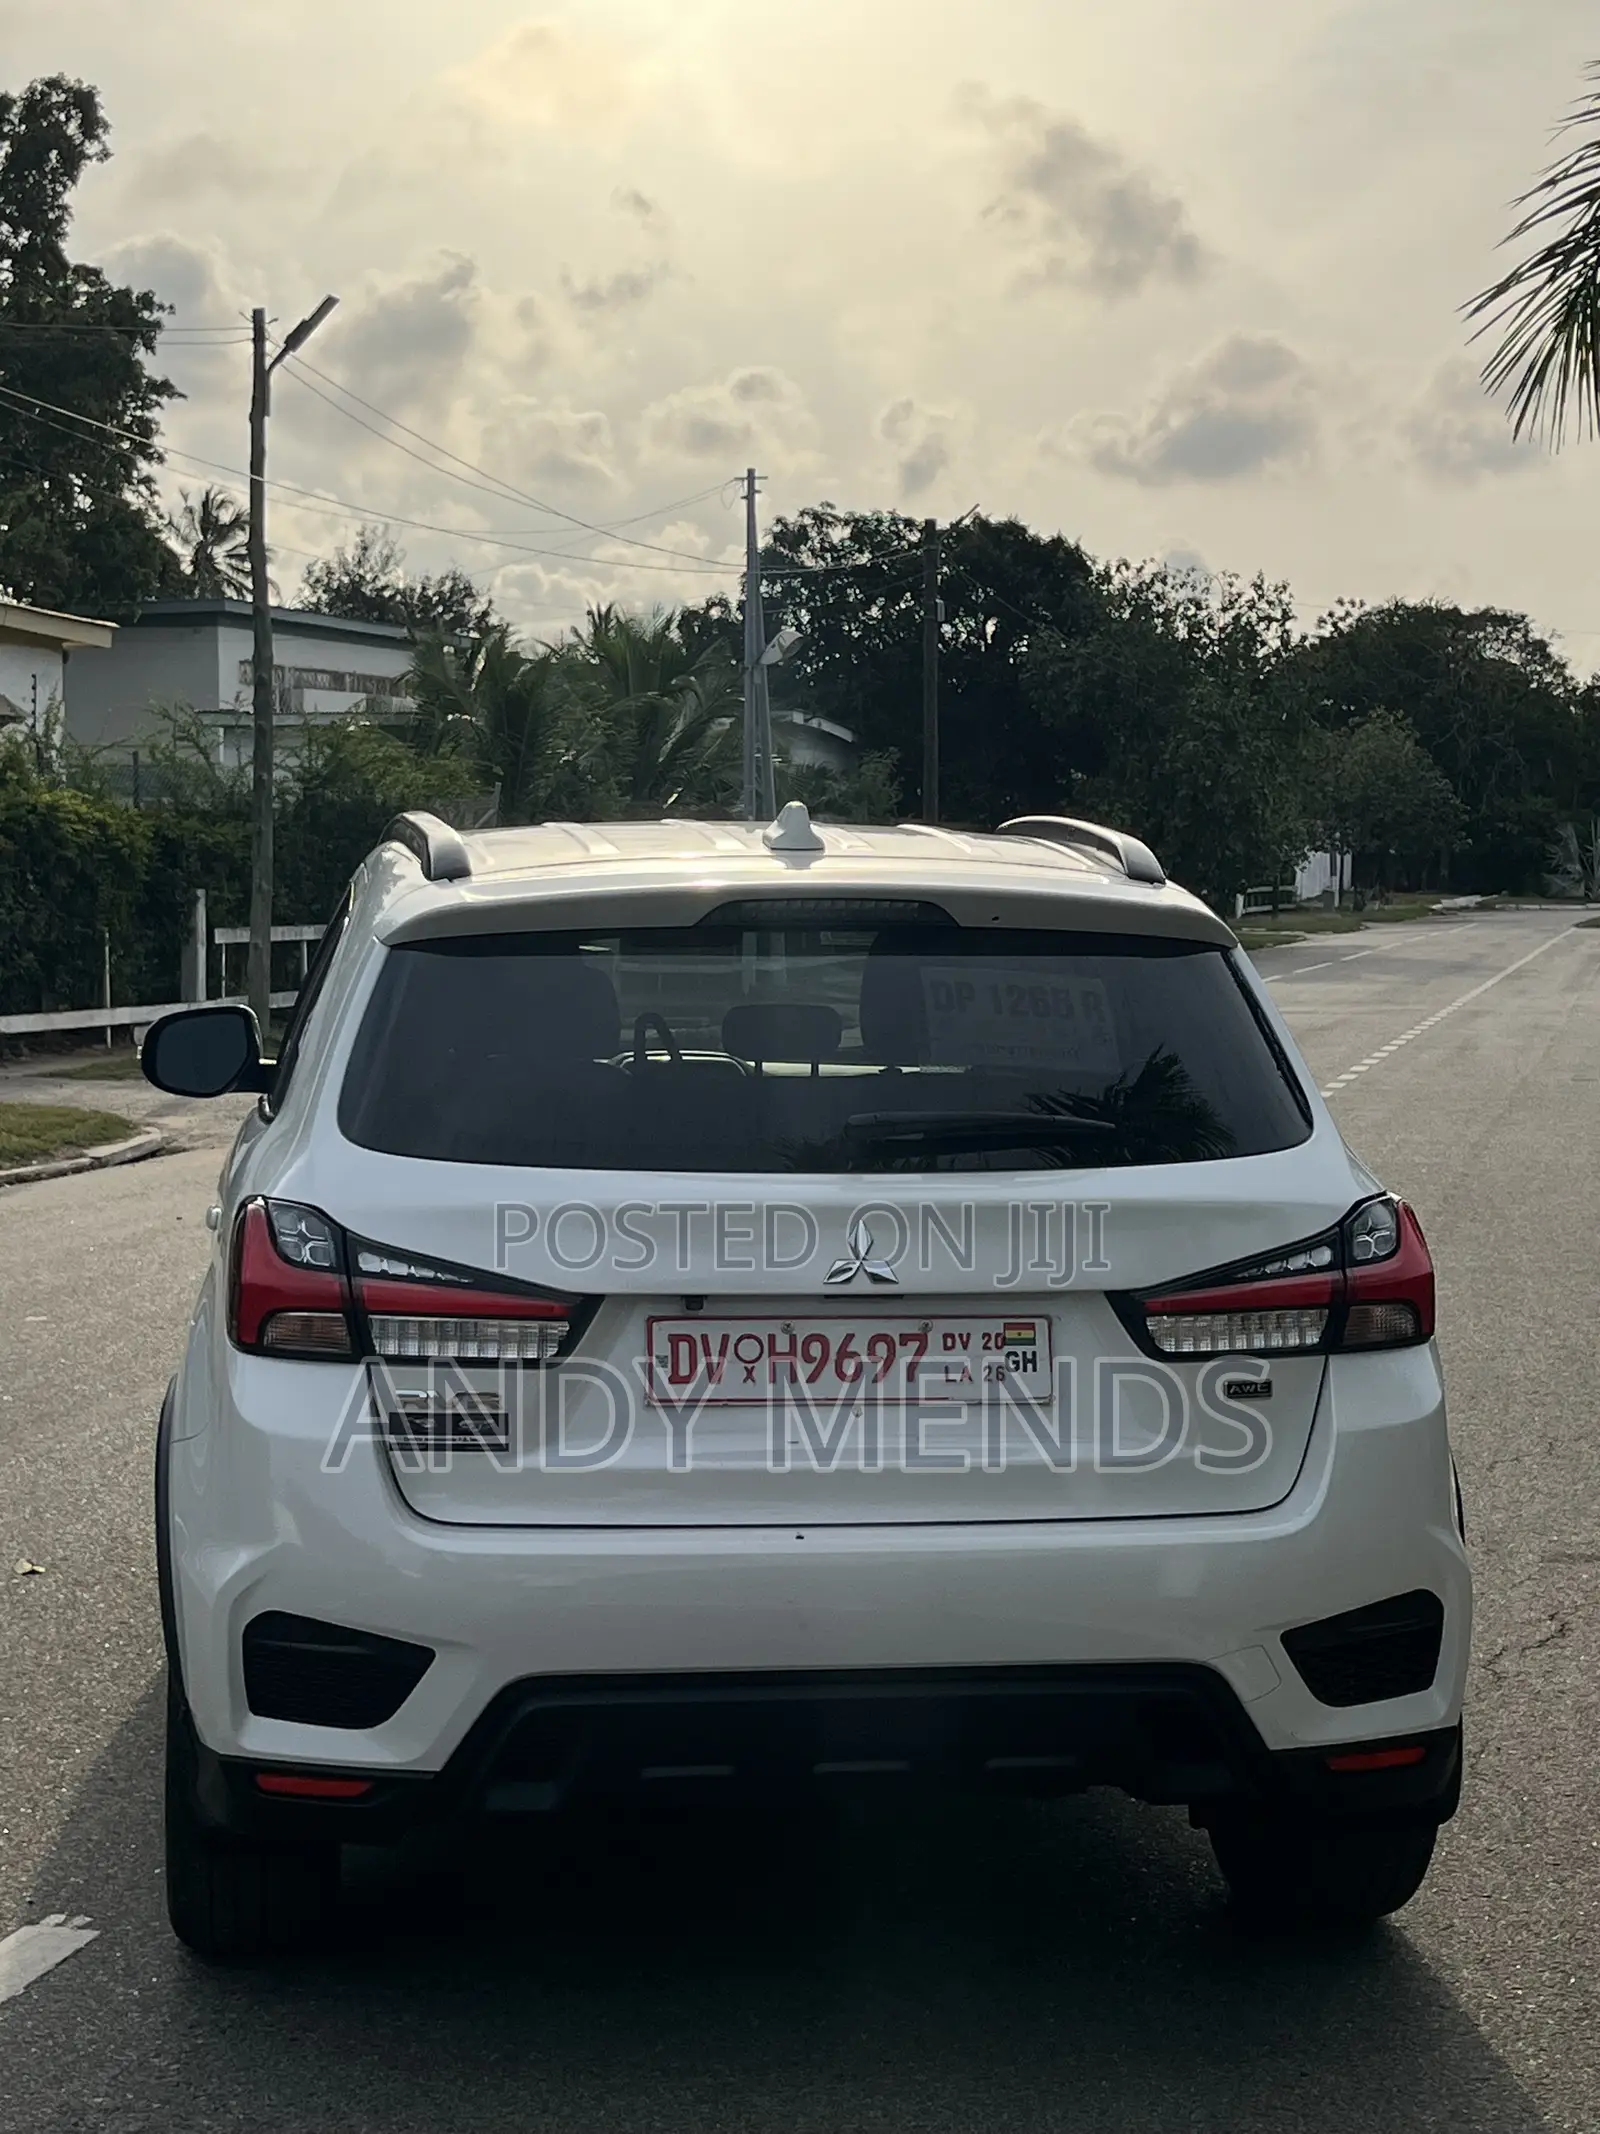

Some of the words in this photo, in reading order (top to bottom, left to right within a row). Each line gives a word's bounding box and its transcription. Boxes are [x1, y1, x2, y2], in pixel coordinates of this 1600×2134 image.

[942, 1332, 971, 1351] DV
[1005, 1350, 1038, 1373] GH
[944, 1365, 973, 1384] LA
